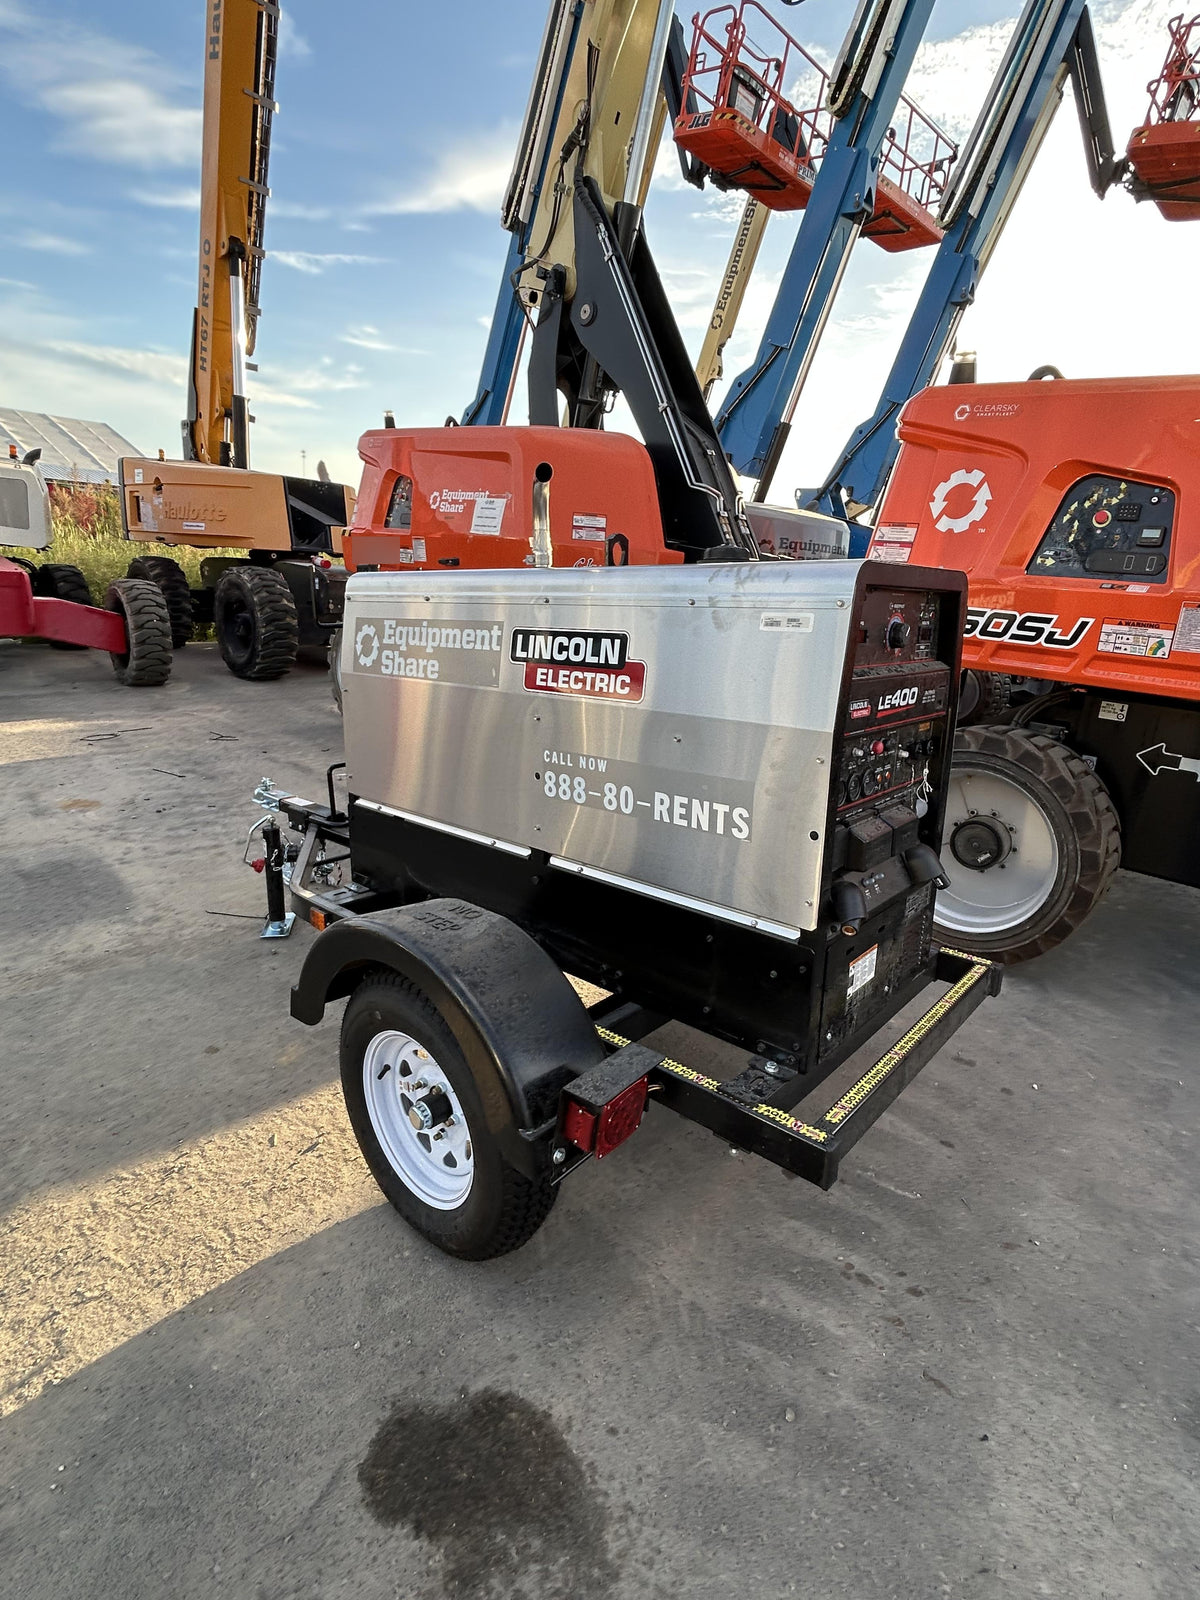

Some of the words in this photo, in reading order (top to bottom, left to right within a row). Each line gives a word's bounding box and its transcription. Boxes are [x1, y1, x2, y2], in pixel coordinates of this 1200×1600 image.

[687, 112, 712, 131] JLG
[202, 264, 210, 308] RTJ
[200, 315, 209, 372] HT67
[973, 404, 1020, 412] CLEARSKY
[442, 489, 489, 502] Equipment
[163, 501, 227, 521] Haulotte
[439, 502, 464, 513] Share
[779, 537, 846, 556] Equipment
[1125, 620, 1160, 629] WARNING
[382, 619, 502, 653] Equipment
[515, 634, 621, 665] LINCOLN
[380, 649, 440, 679] Share
[535, 667, 631, 695] ELECTRIC
[877, 686, 919, 711] LE400
[543, 750, 573, 767] CALL
[579, 756, 608, 773] NOW
[543, 770, 750, 839] 888-80-RENTS
[413, 912, 463, 932] STEP
[448, 905, 483, 920] NO
[845, 1095, 856, 1105] DO
[856, 1084, 868, 1097] NOT
[864, 1068, 884, 1086] STAND
[882, 1056, 897, 1070] HERE
[764, 1108, 791, 1122] AQUI
